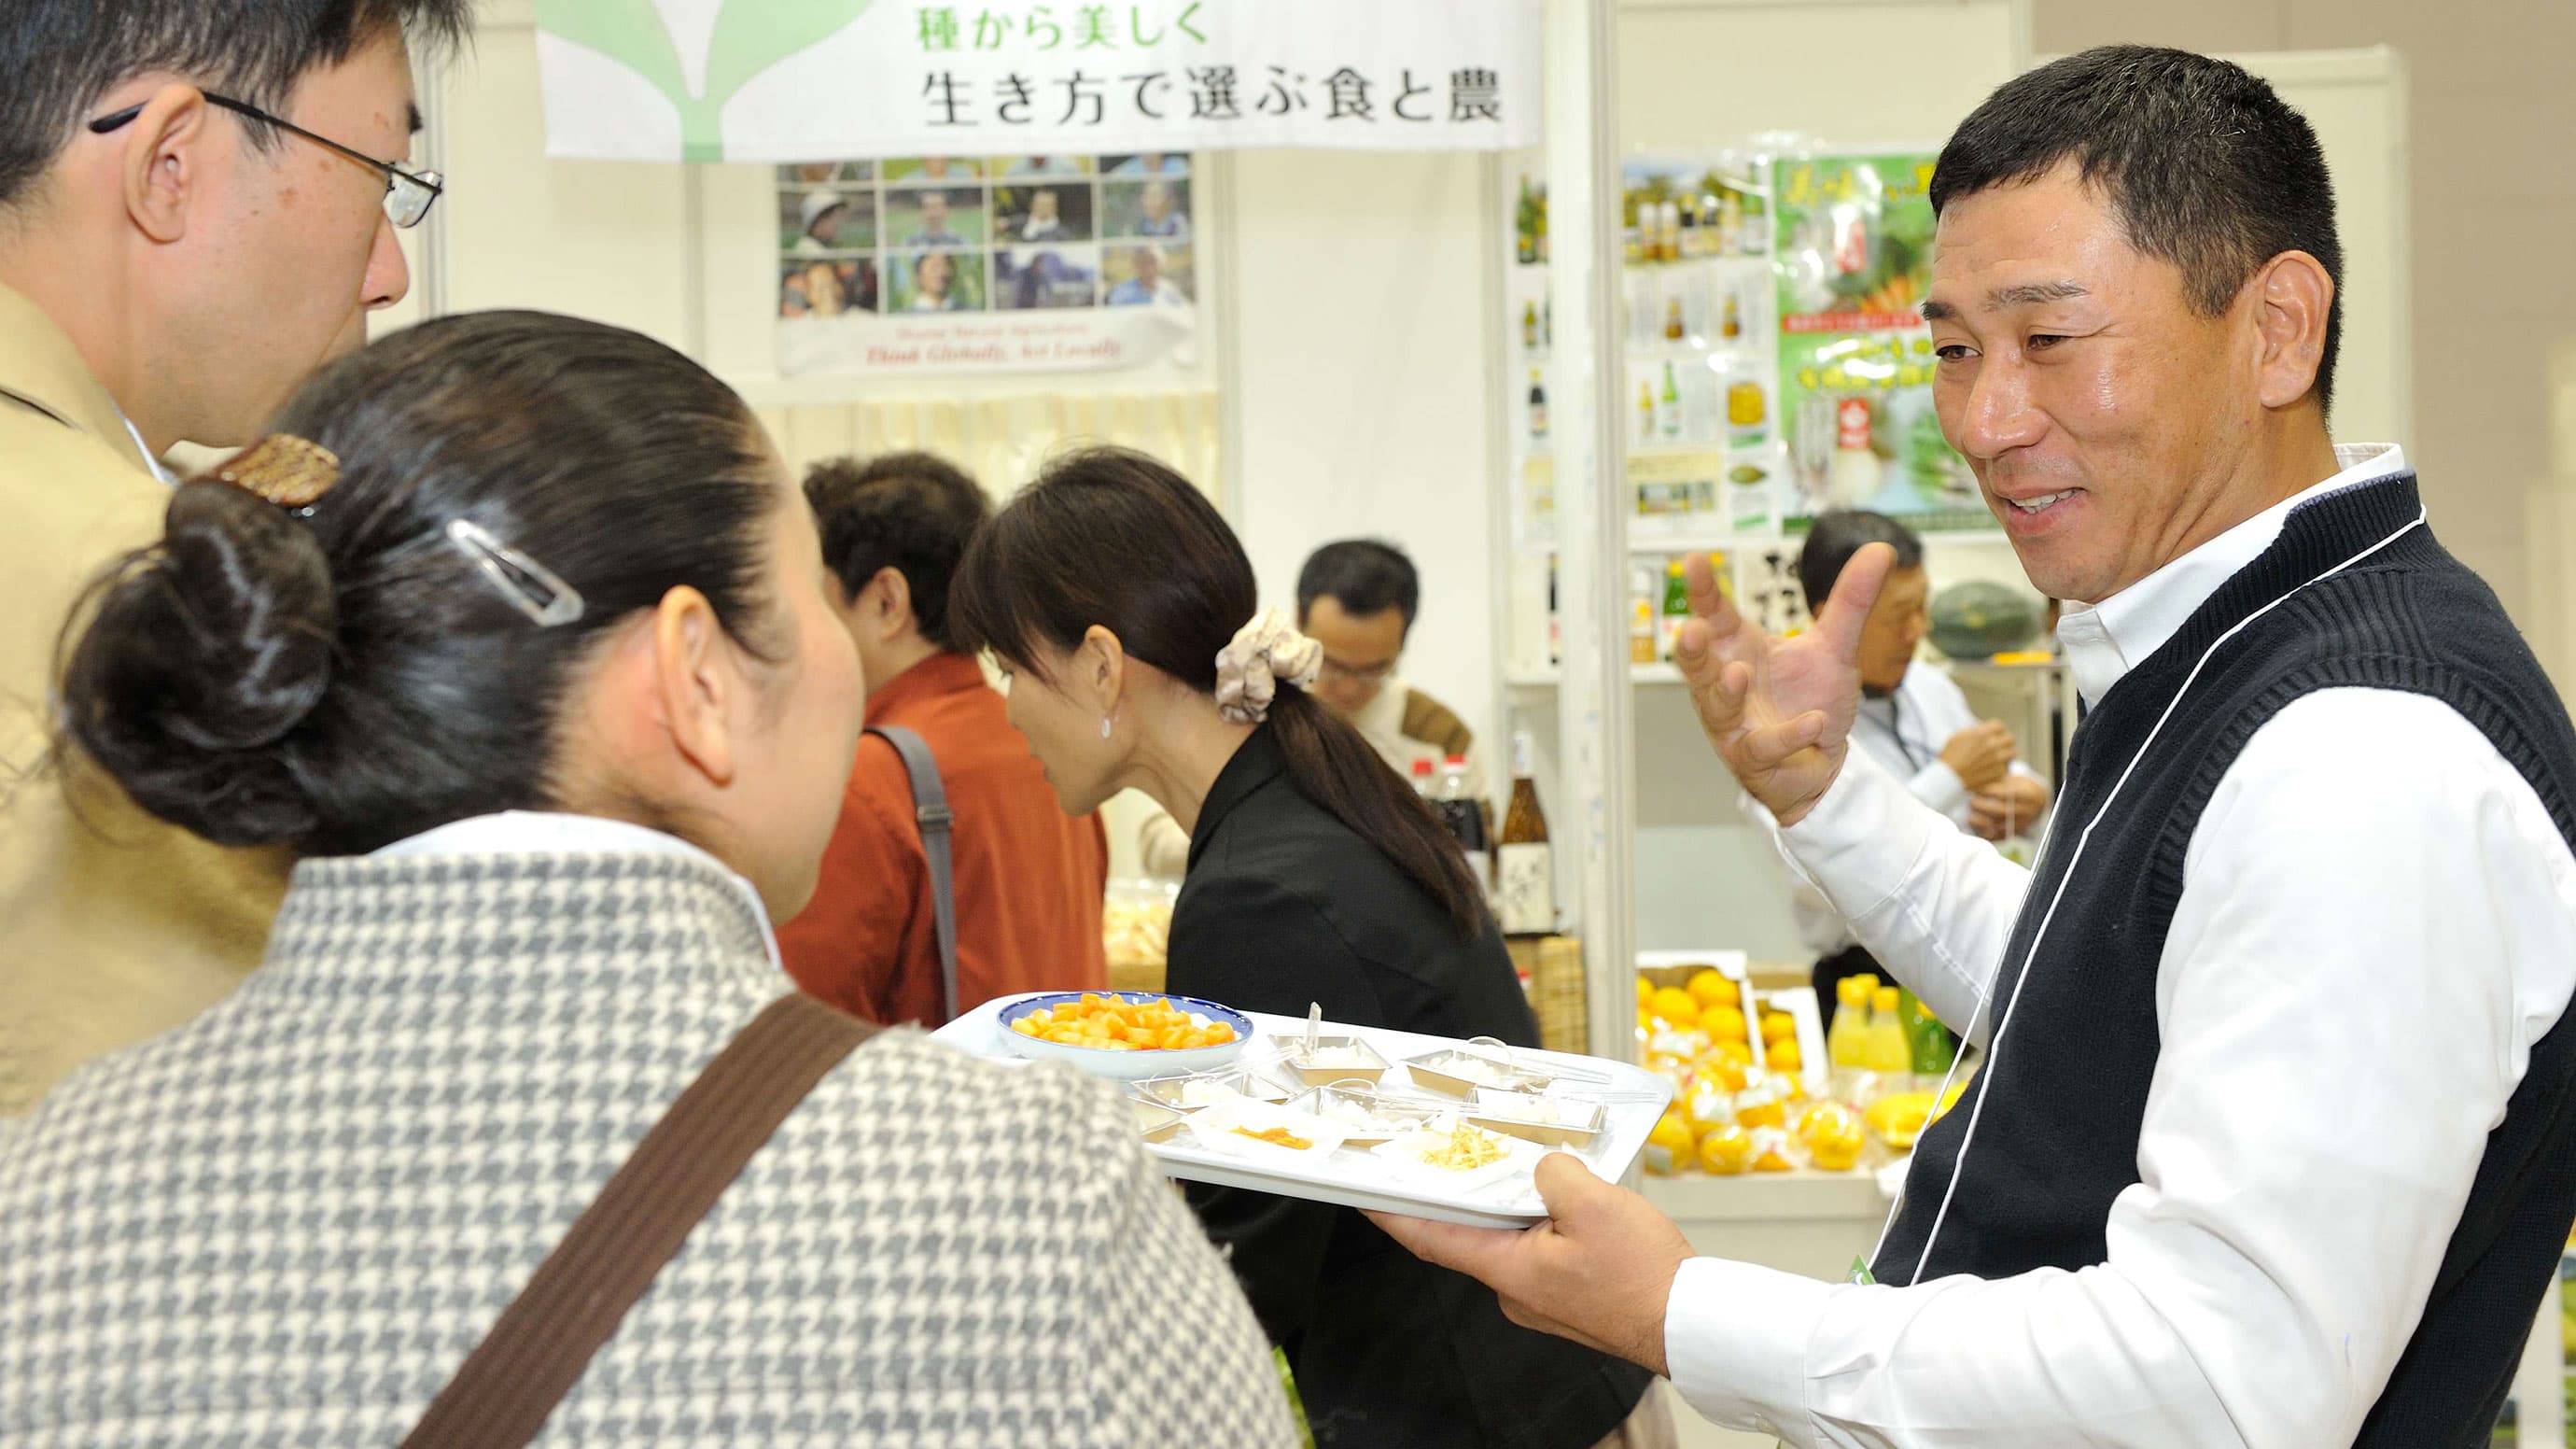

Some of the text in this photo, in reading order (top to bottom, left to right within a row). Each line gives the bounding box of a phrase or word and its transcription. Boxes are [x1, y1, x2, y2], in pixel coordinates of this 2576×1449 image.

[917, 2, 1208, 50] 種から美しく
[922, 64, 1503, 127] 生き方で選ぶ食と農
[865, 345, 918, 365] Think
